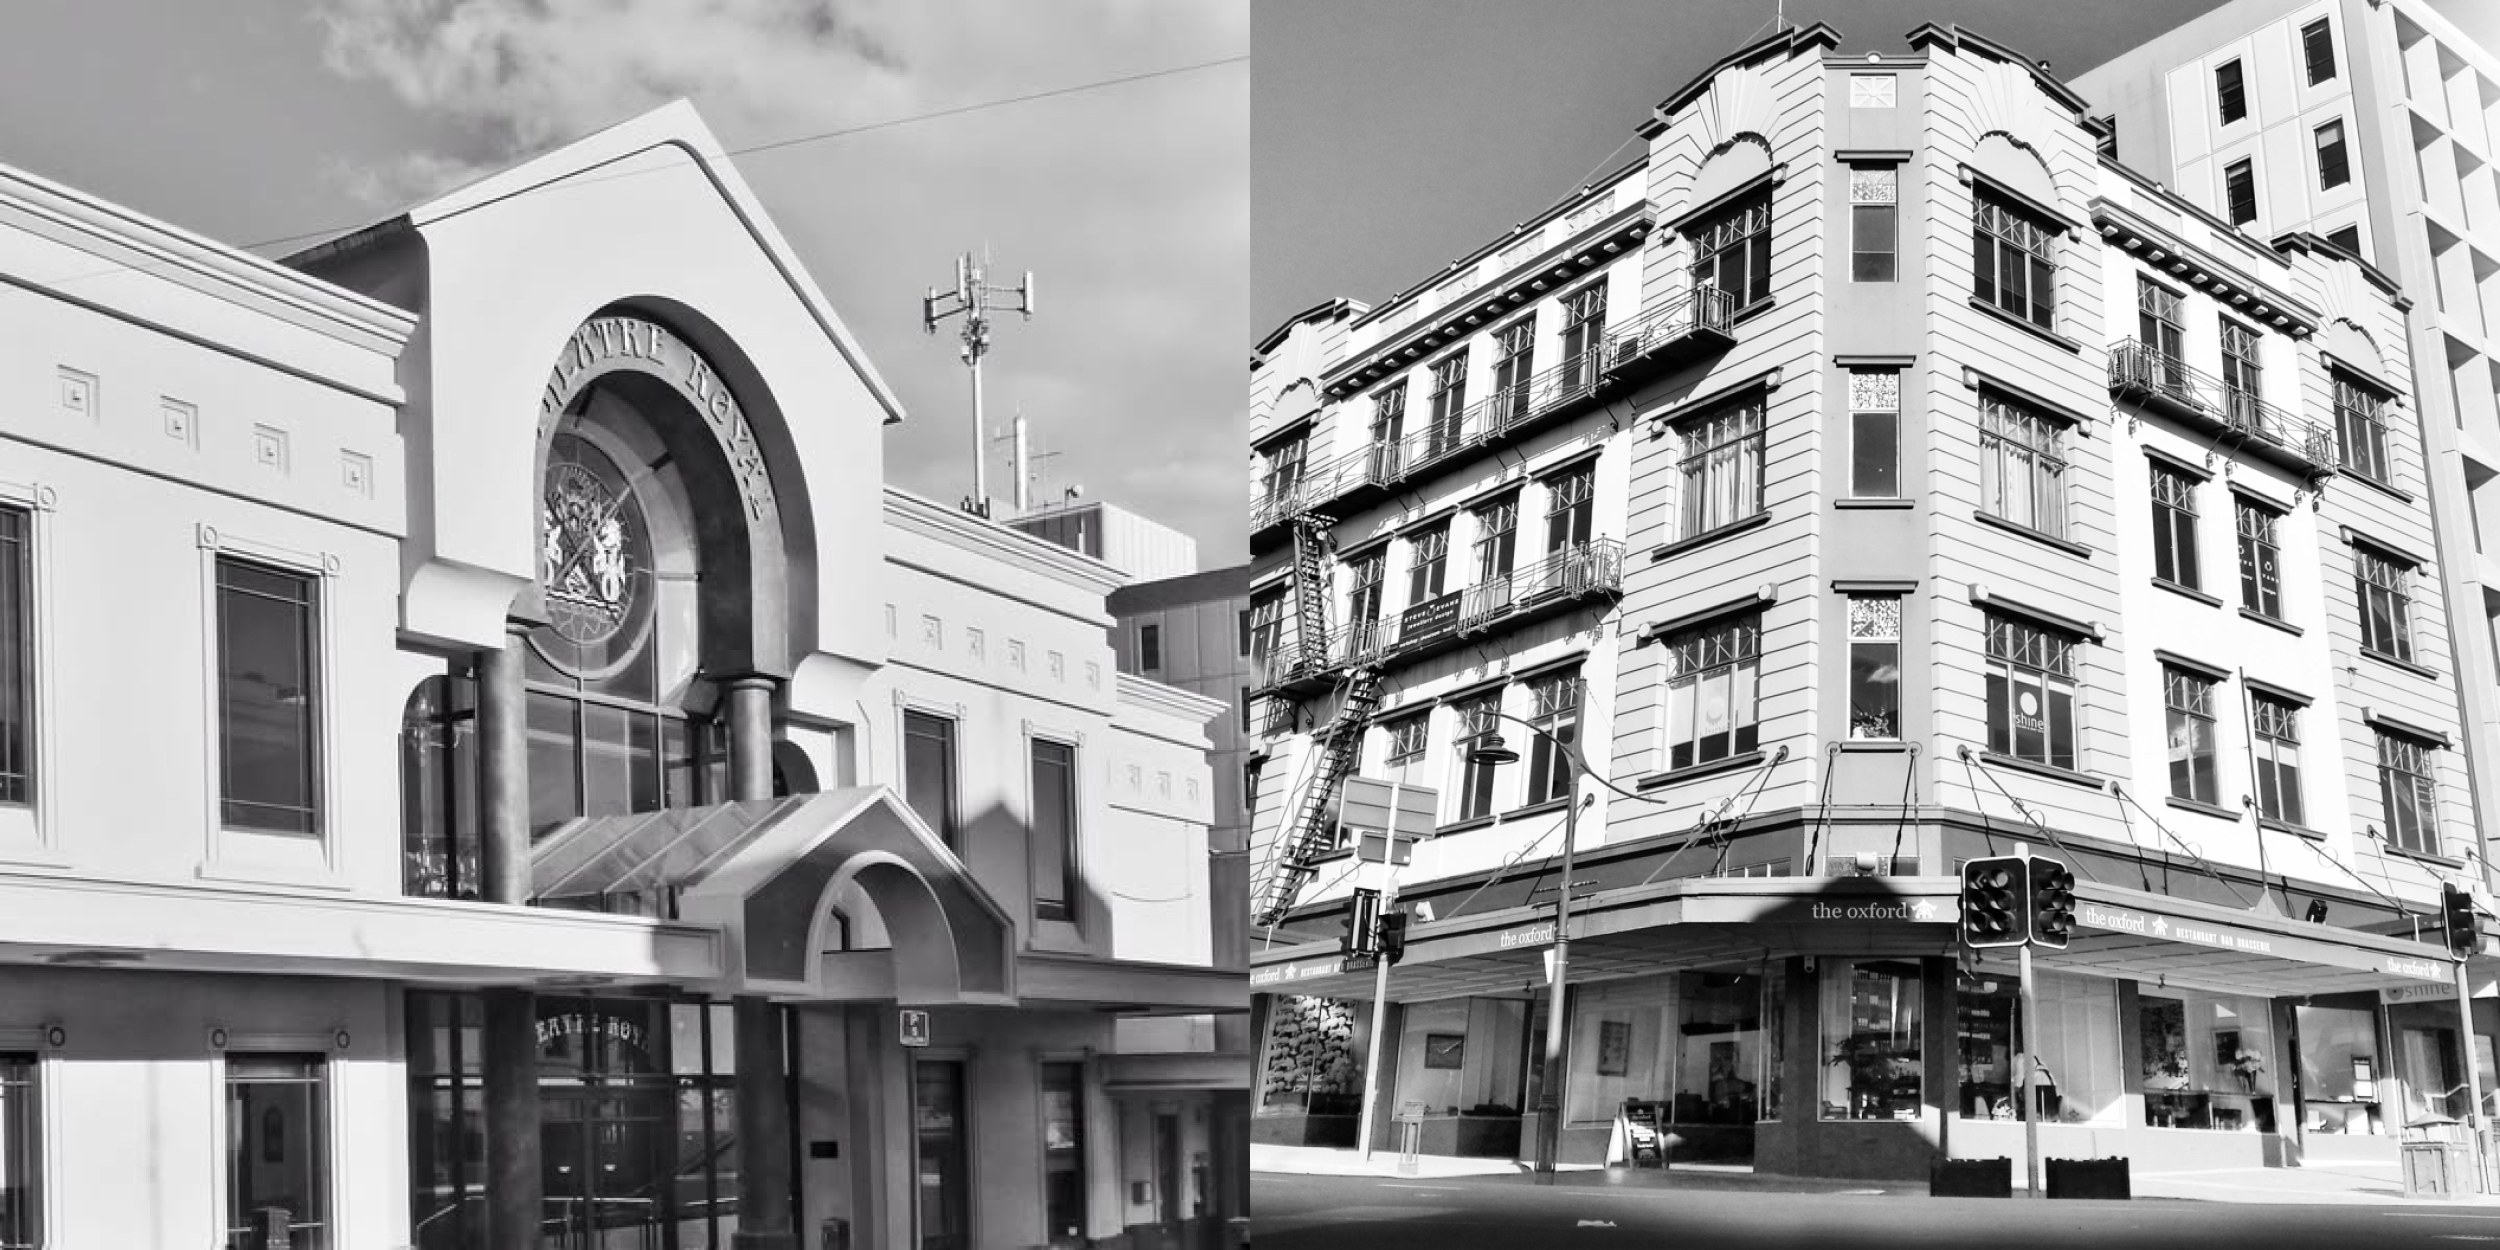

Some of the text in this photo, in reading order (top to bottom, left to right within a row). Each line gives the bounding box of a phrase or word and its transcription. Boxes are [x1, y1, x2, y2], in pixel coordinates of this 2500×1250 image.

[1404, 598, 1459, 623] STEVE EVANS
[2015, 712, 2044, 730] shine
[1812, 901, 1908, 920] the oxford
[2086, 907, 2145, 934] the oxford
[1500, 924, 1553, 948] the oxford
[2176, 927, 2271, 953] RESTAURANT BAR BRASSERIE
[1255, 967, 1281, 984] oxford
[2387, 957, 2430, 977] the oxford
